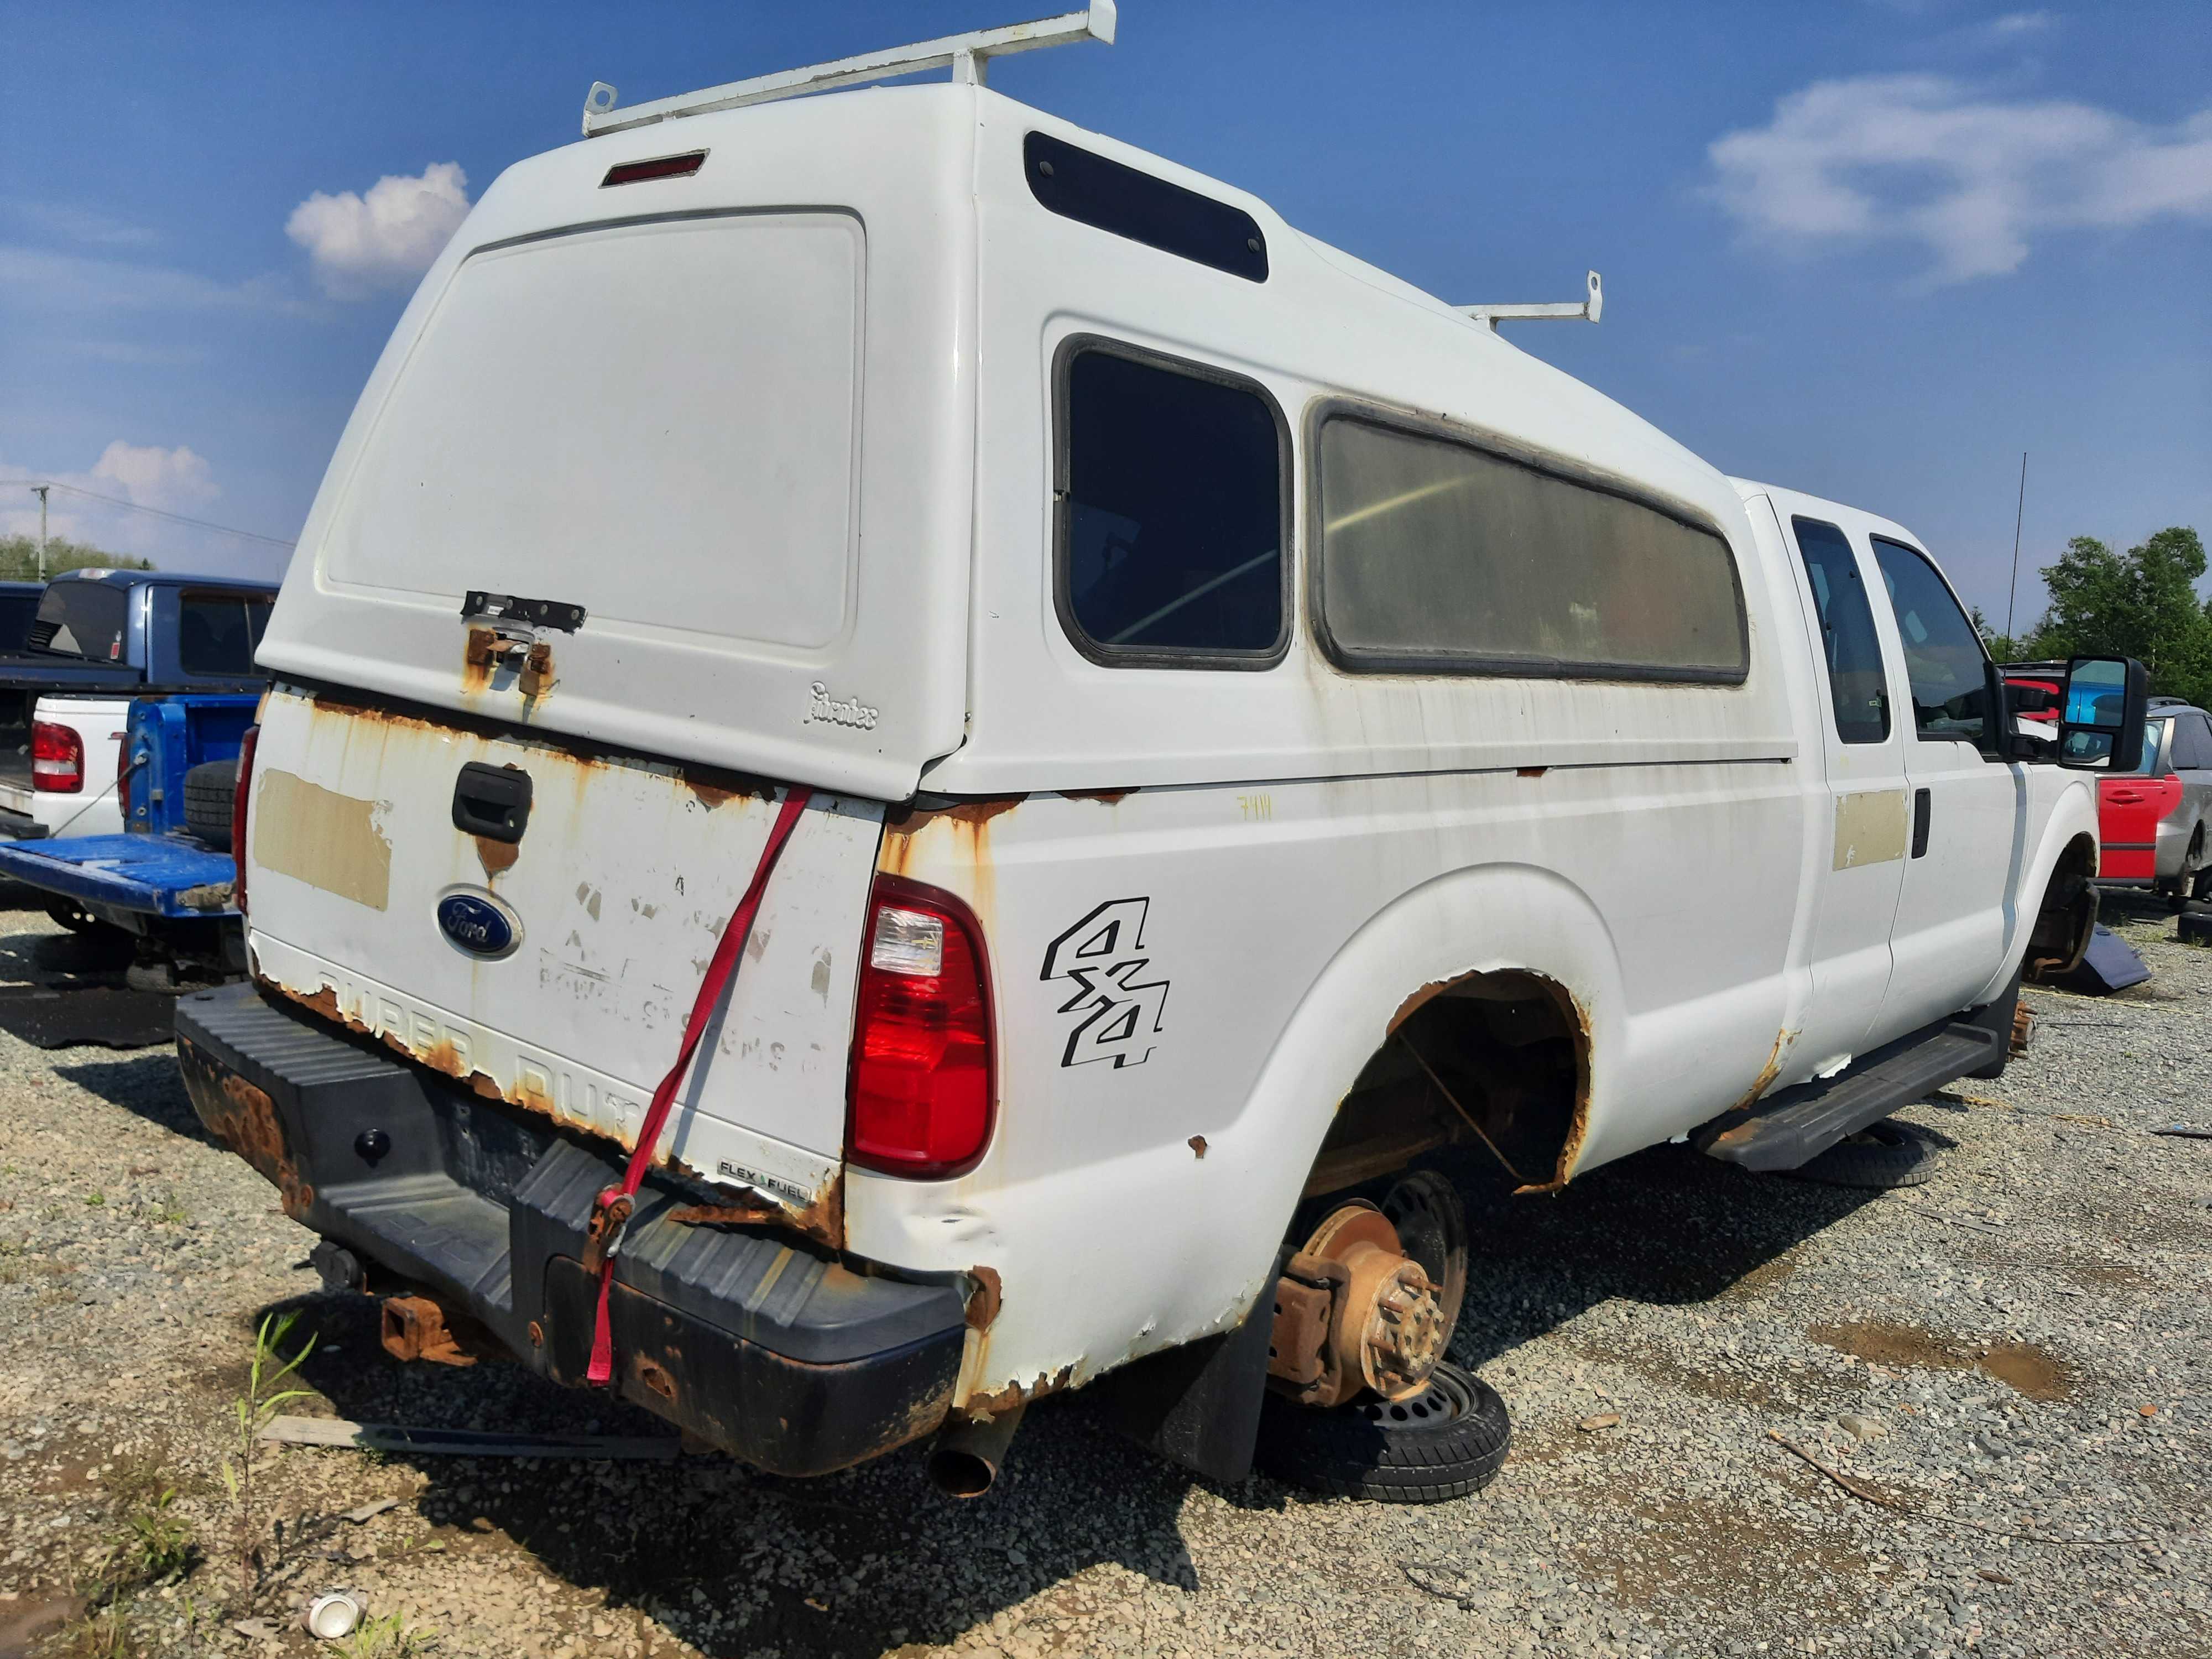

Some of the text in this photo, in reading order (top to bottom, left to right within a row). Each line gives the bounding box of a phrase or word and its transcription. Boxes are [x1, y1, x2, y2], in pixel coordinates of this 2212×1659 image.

[447, 901, 491, 942] Ford
[720, 1161, 806, 1201] FLEX FUEL
